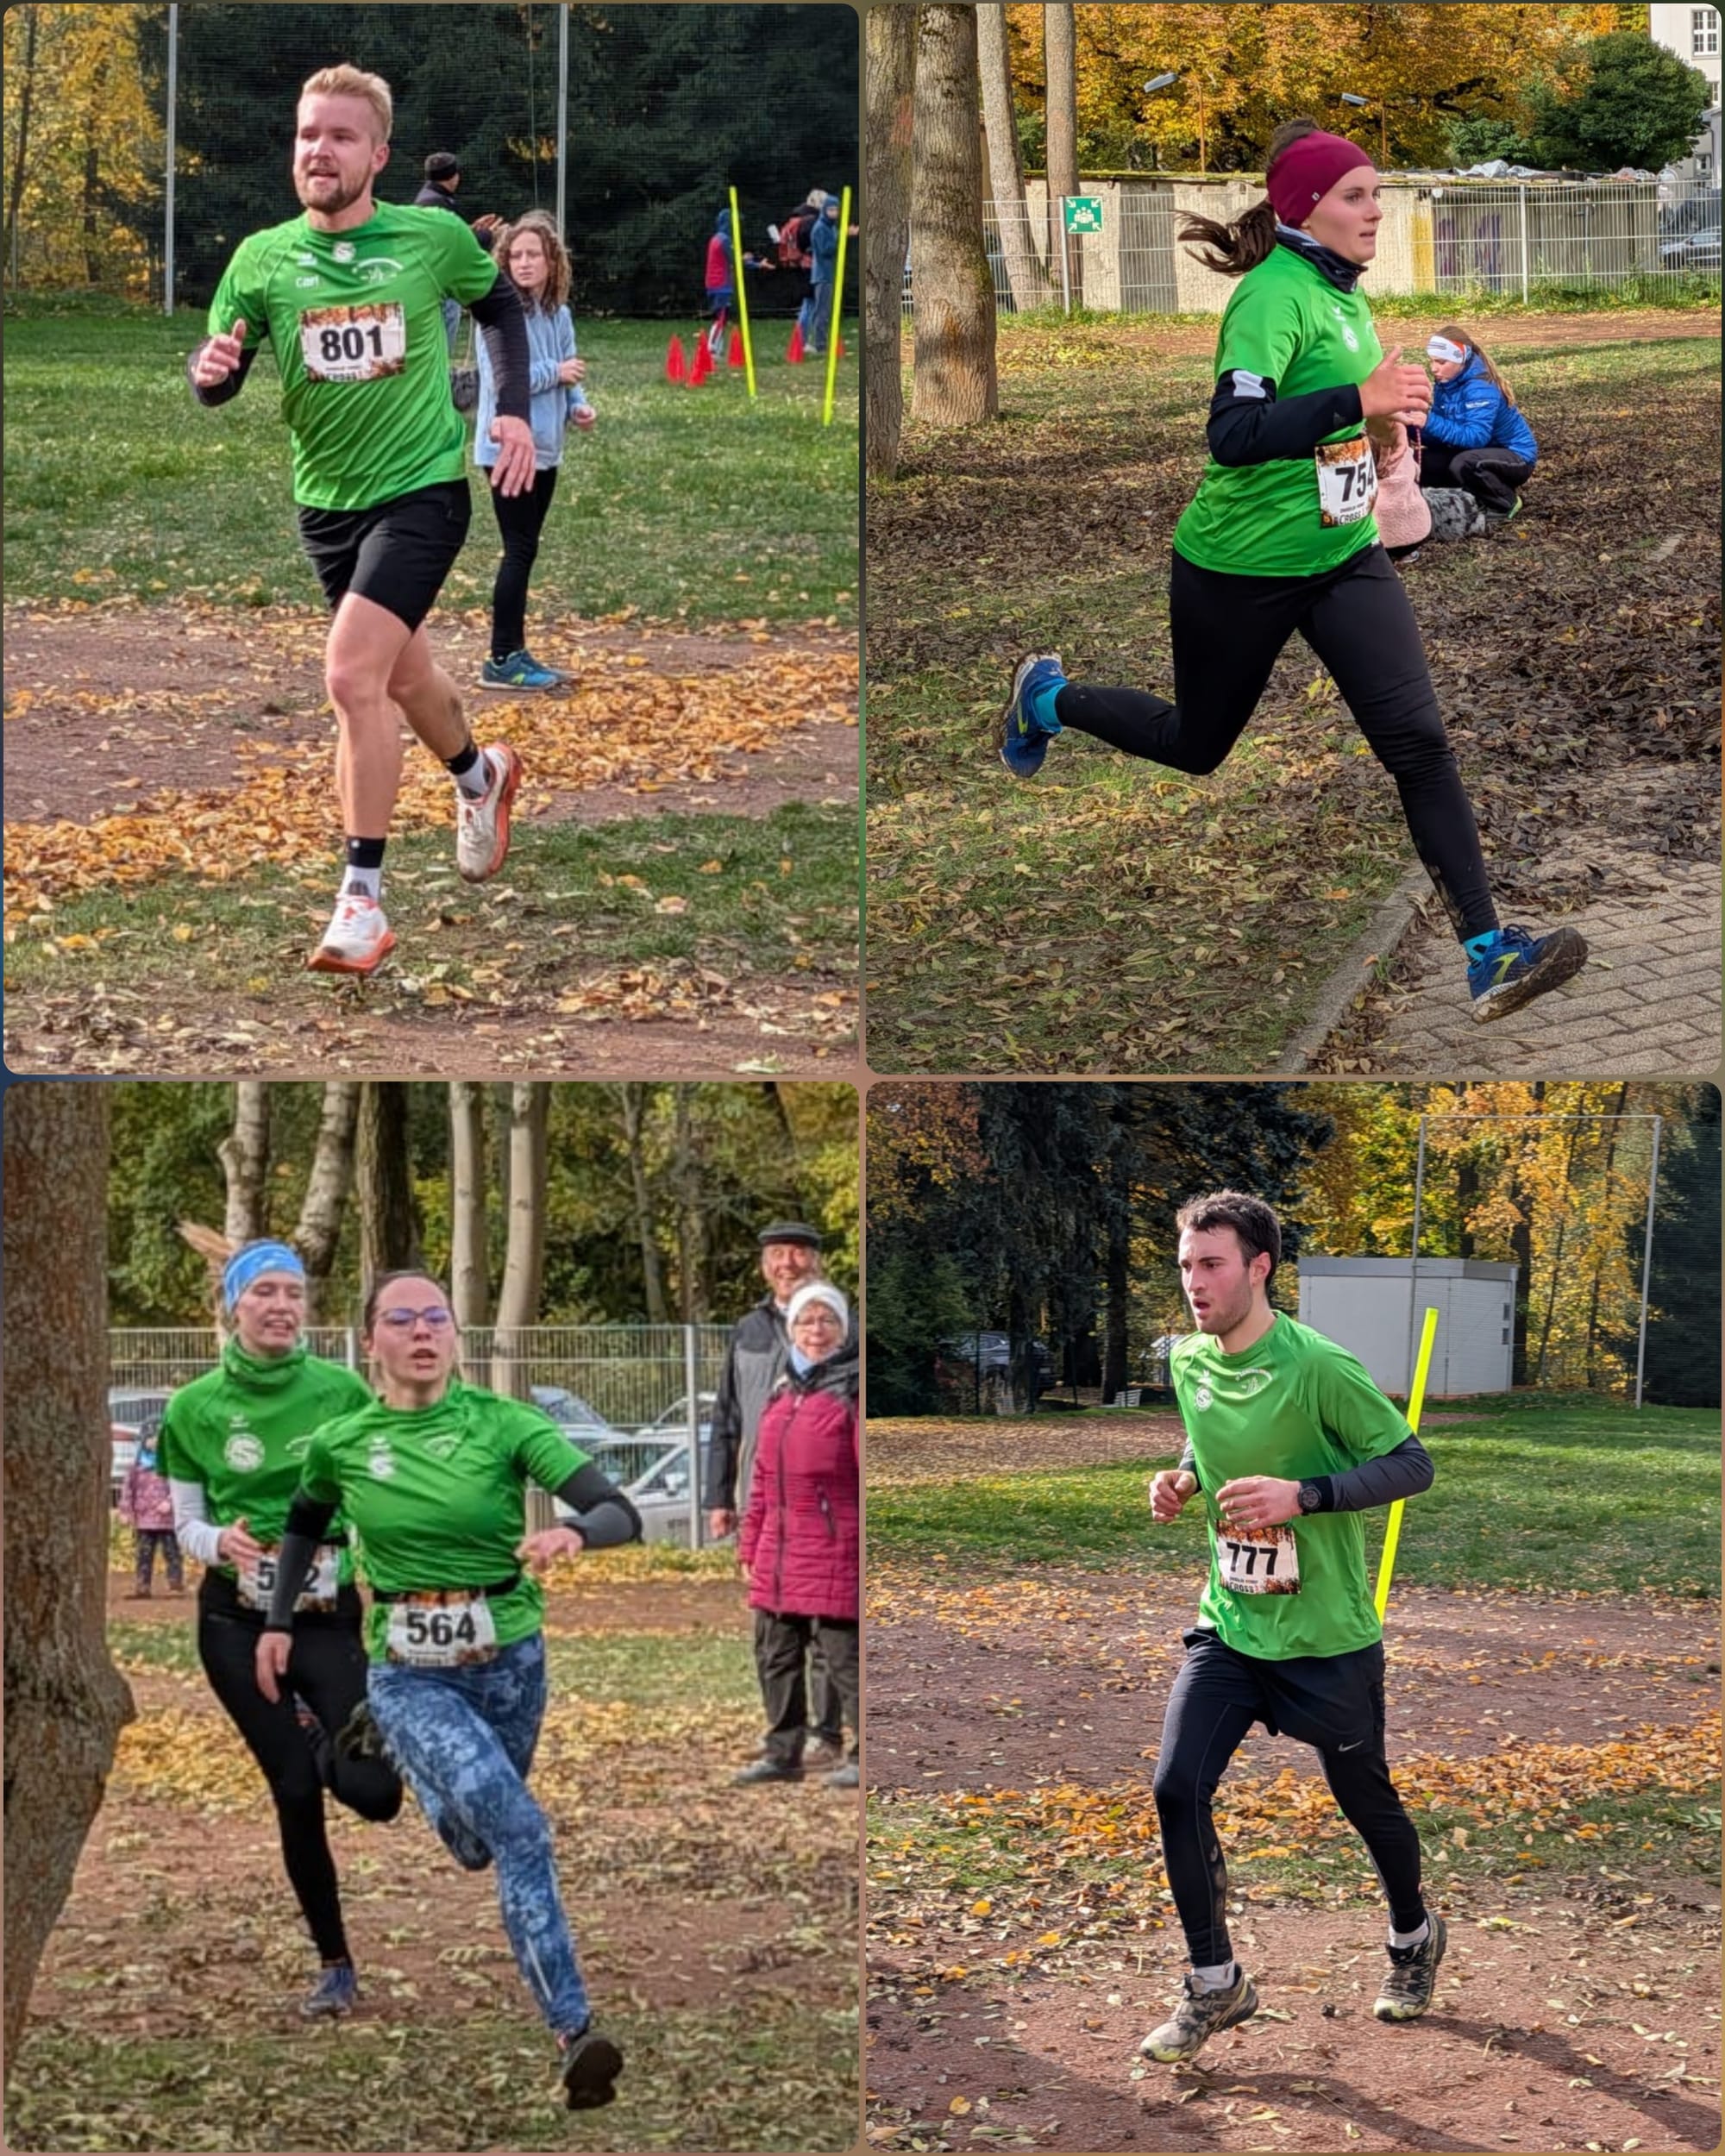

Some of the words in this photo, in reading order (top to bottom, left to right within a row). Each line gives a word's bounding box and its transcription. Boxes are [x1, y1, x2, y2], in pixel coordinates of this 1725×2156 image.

[320, 326, 383, 361] 801
[1335, 457, 1374, 502] 754
[1226, 1542, 1278, 1576] 777
[257, 1561, 320, 1593] 52
[407, 1611, 476, 1646] 564
